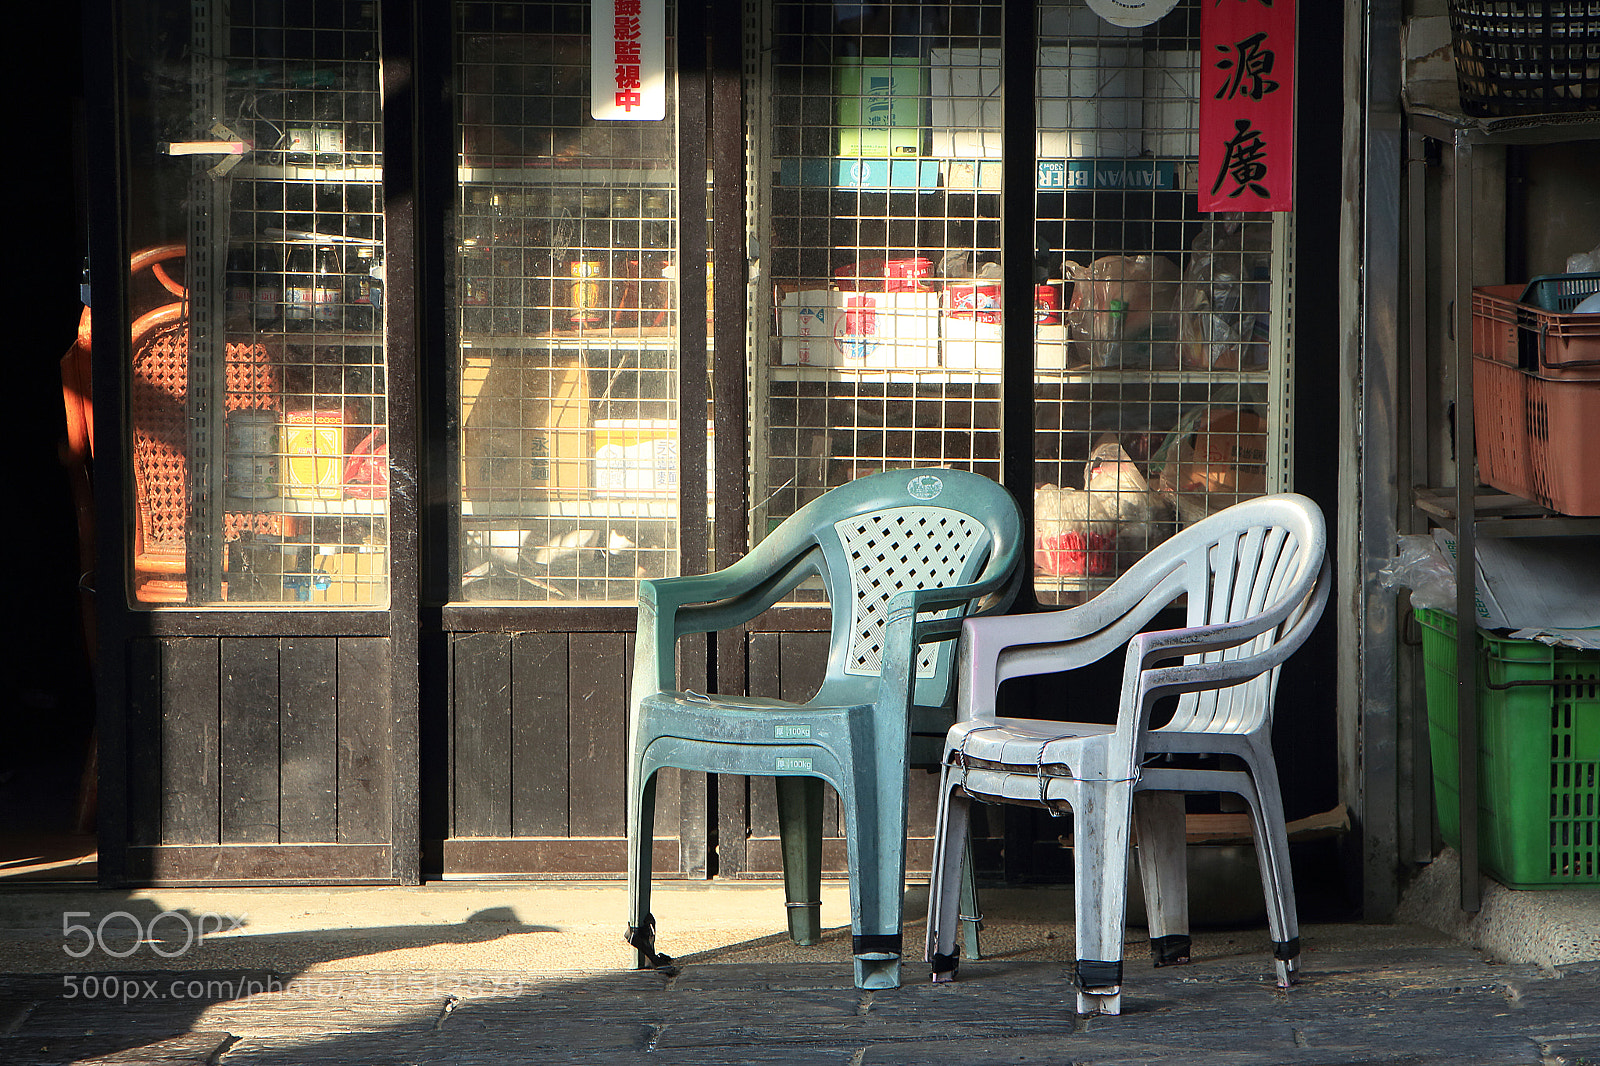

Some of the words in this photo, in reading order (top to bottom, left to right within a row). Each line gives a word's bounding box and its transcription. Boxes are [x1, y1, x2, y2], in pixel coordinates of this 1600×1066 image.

[1211, 0, 1280, 199] 源廣
[1038, 170, 1089, 187] BEER
[1097, 170, 1165, 186] TAIWAN
